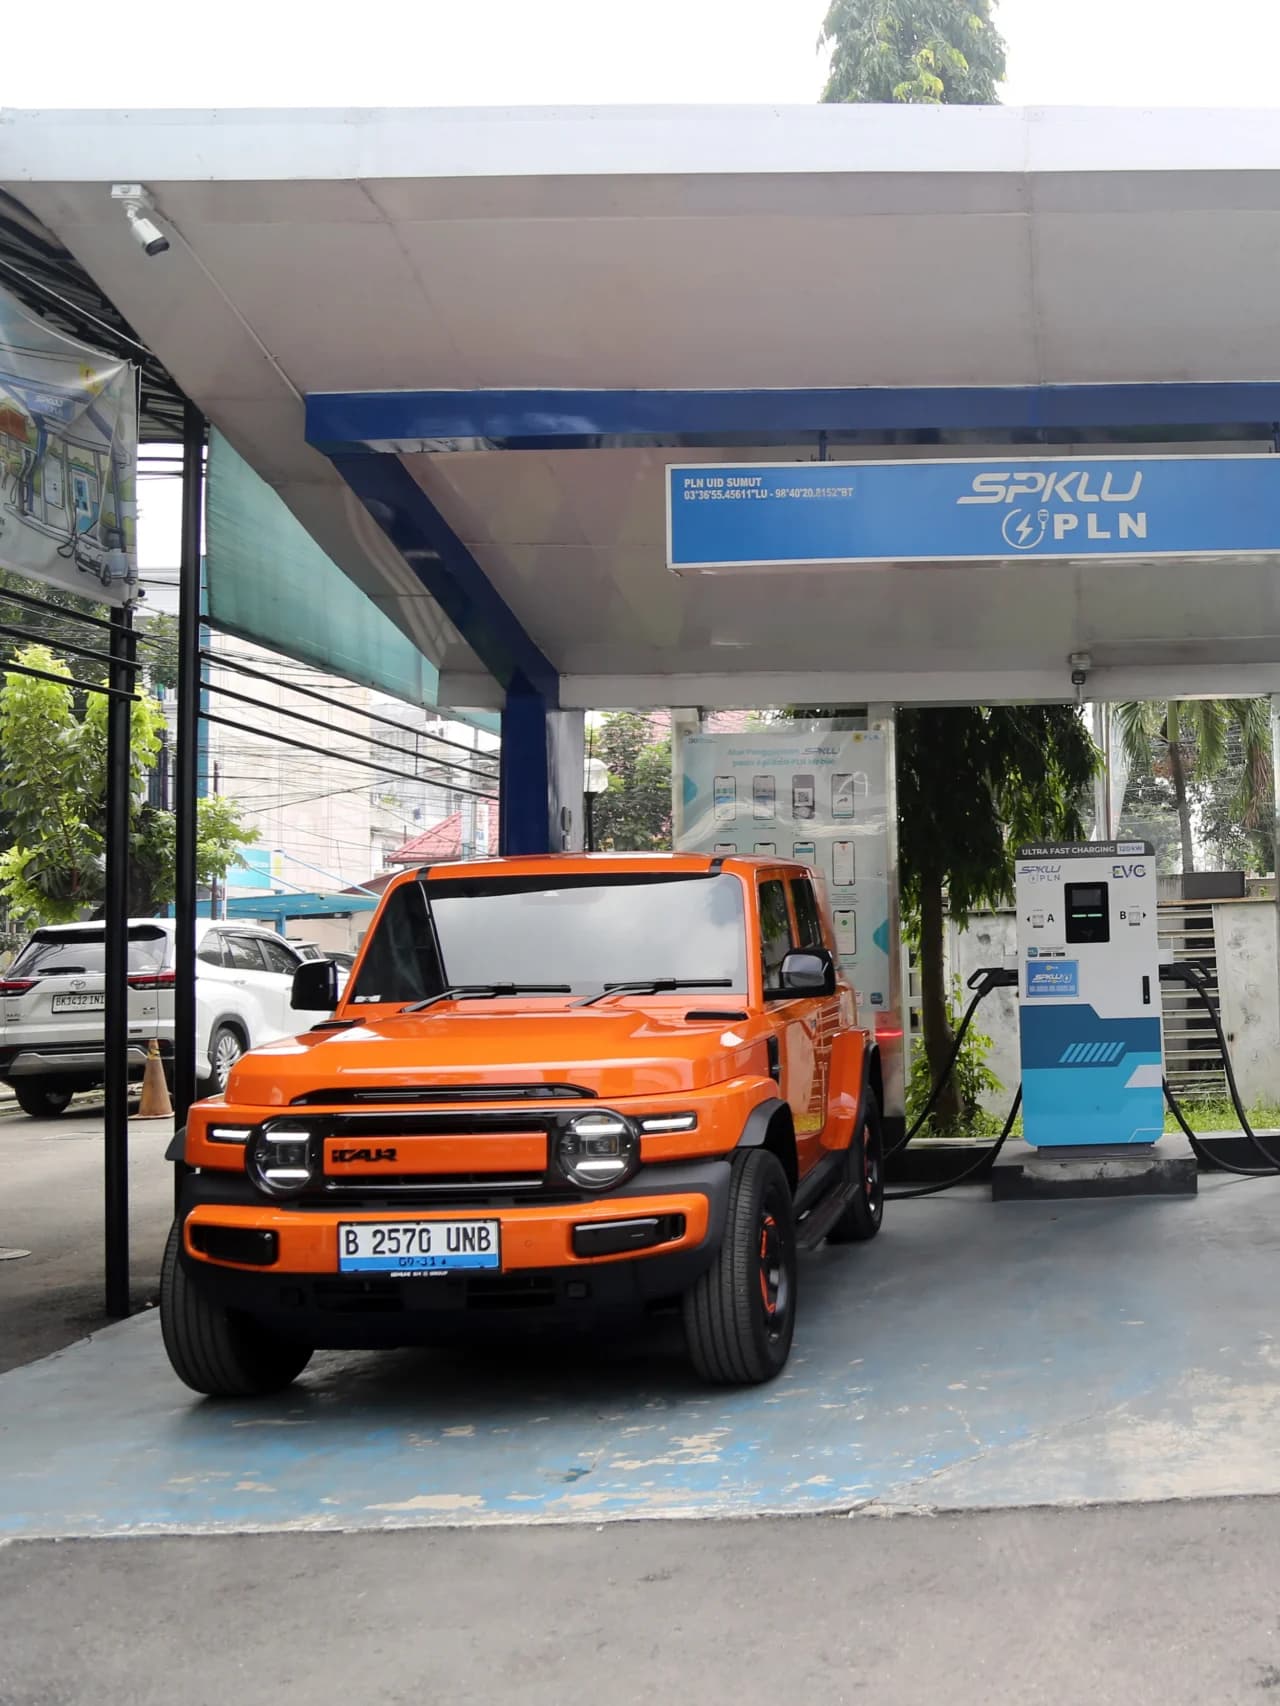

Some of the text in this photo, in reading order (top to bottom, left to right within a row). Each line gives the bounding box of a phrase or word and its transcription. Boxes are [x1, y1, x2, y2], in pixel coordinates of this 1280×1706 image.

[684, 478, 762, 488] PLN UID SUMUT
[956, 471, 1143, 504] SPKLU
[1053, 512, 1147, 540] PLN
[1022, 848, 1048, 856] ULTRA
[1049, 847, 1070, 855] FAST
[1072, 845, 1115, 854] CHARGING
[1112, 864, 1147, 879] EVC
[1047, 914, 1055, 922] A
[1120, 911, 1127, 920] B
[345, 1226, 491, 1255] B 2570 UNB
